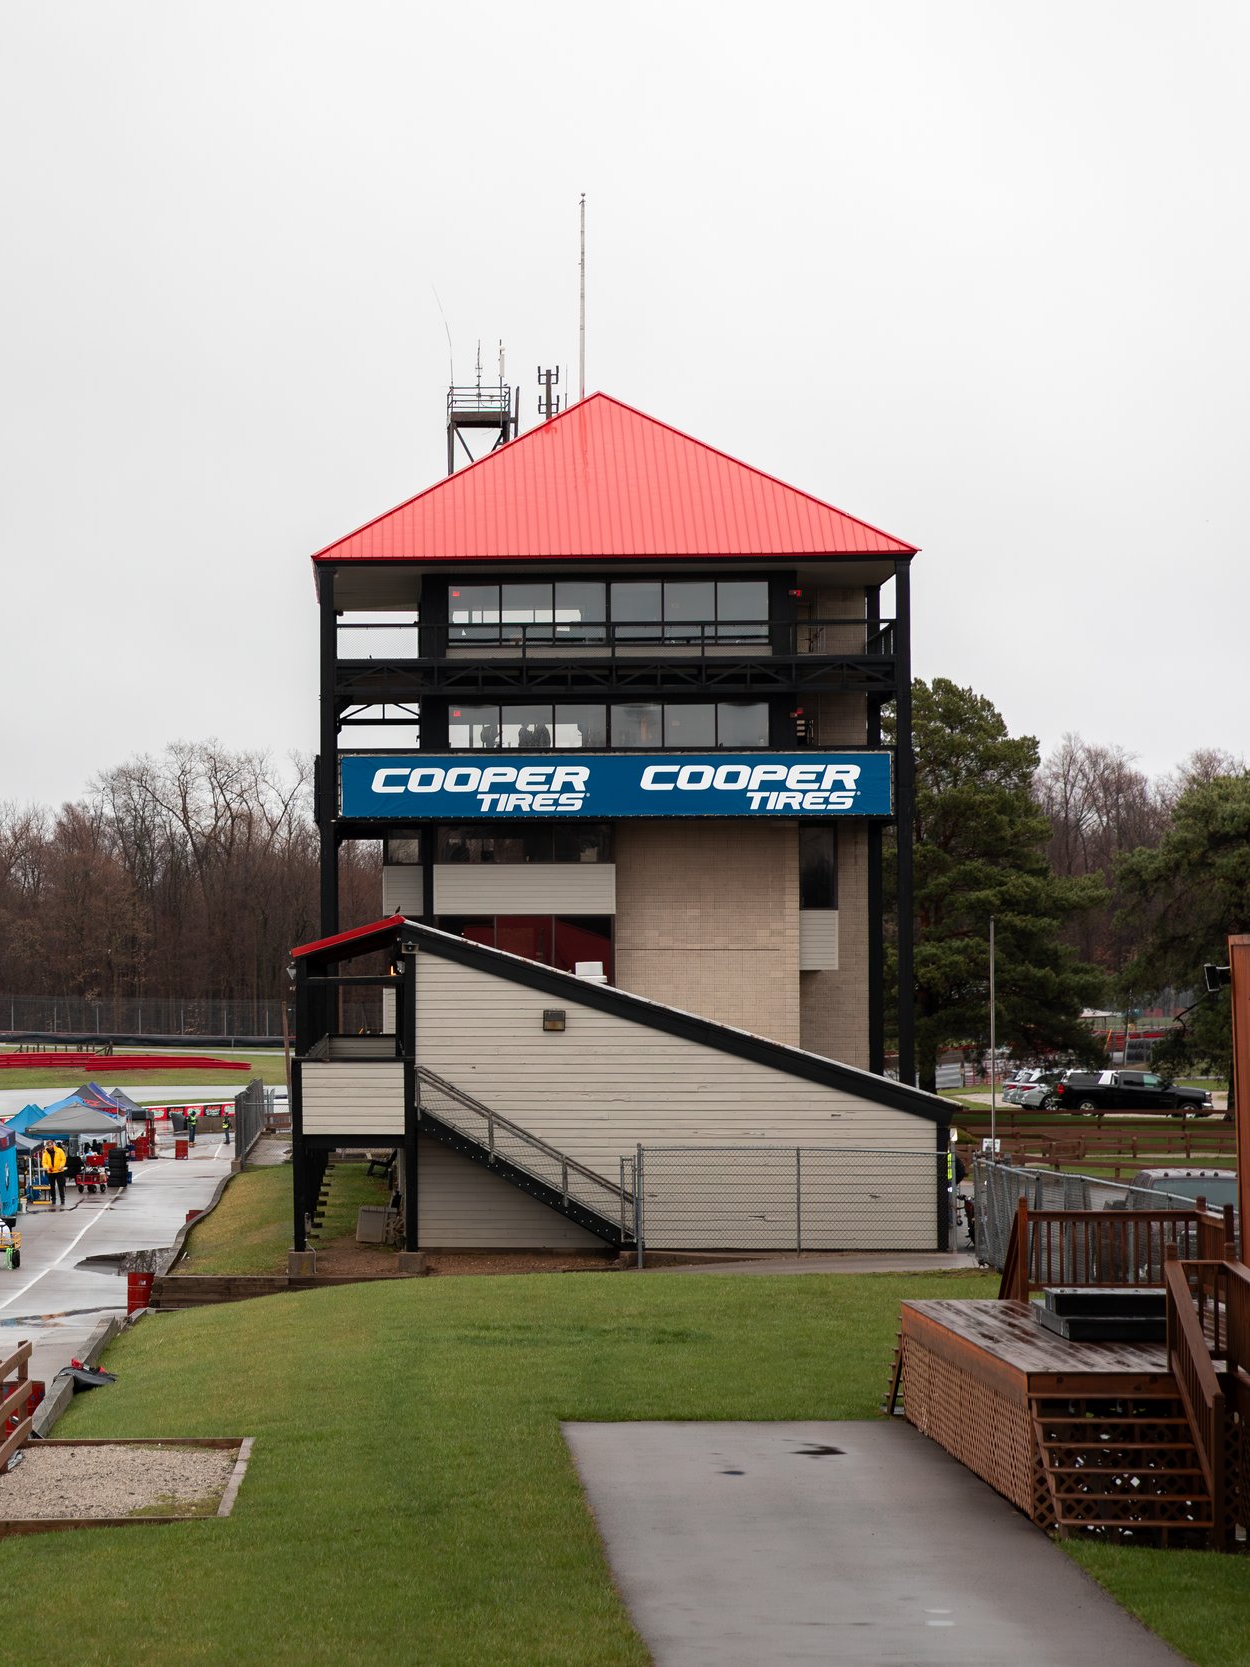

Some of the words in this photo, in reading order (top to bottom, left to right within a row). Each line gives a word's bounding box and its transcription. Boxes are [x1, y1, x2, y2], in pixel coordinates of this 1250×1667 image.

[371, 766, 591, 793] COOPER
[640, 764, 861, 791] COOPER
[476, 793, 586, 812] TIRES
[746, 791, 857, 810] TIRES
